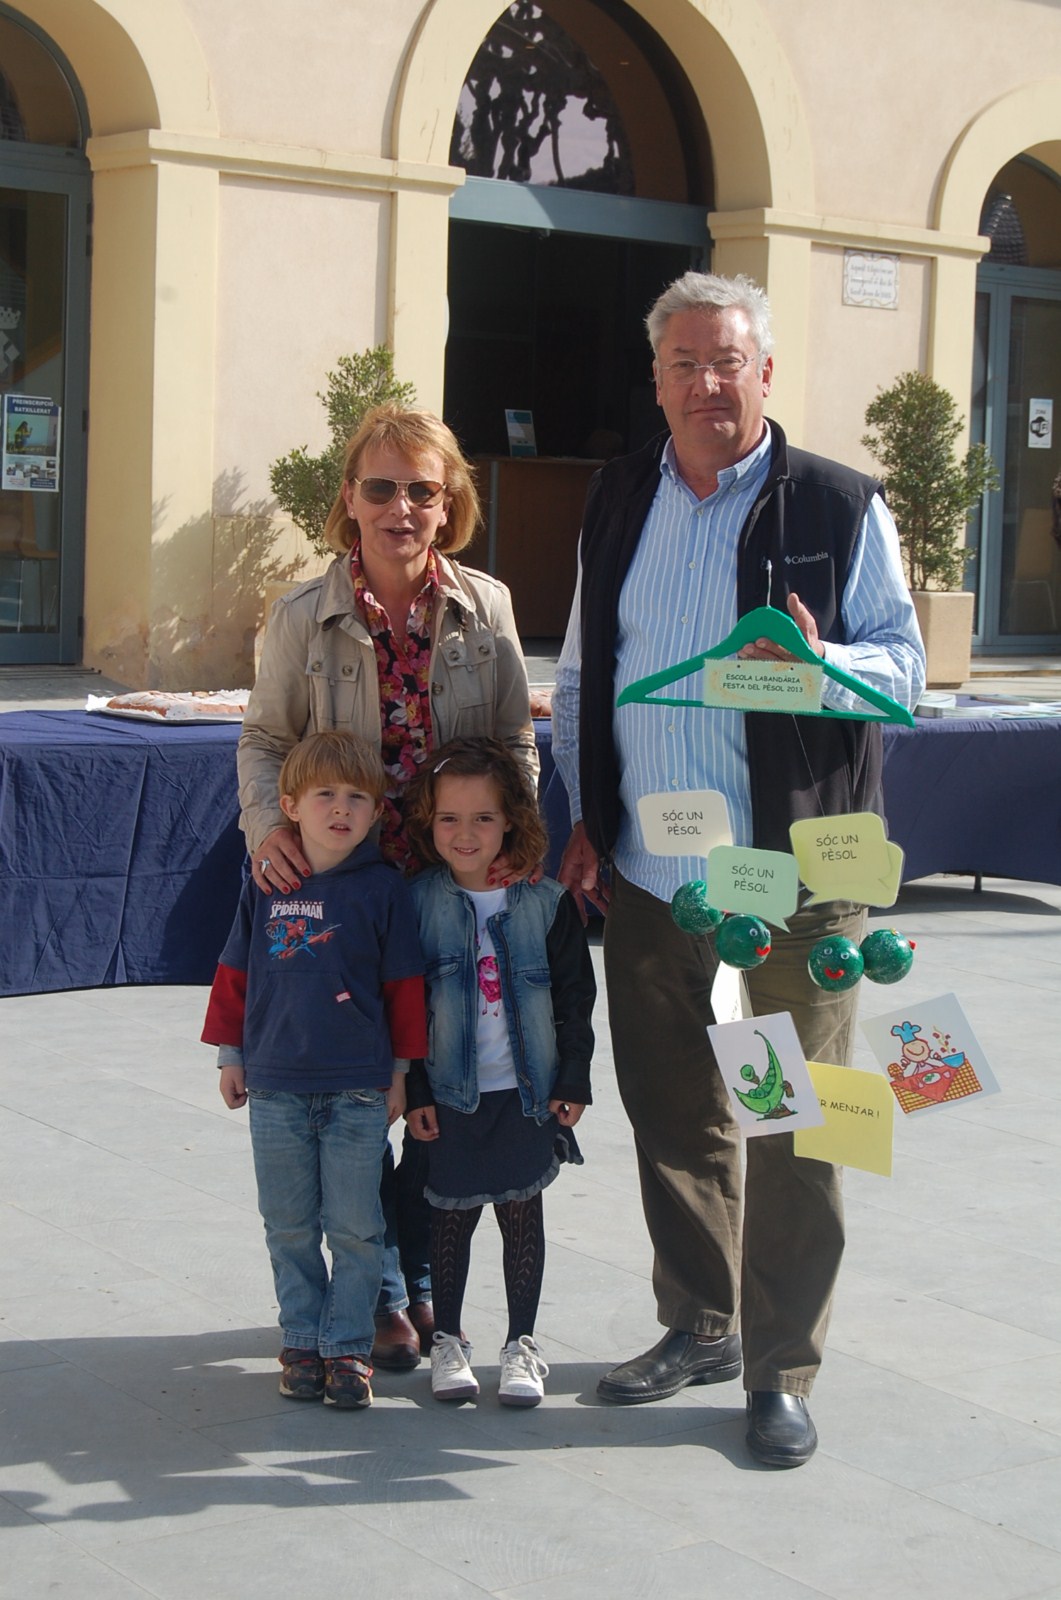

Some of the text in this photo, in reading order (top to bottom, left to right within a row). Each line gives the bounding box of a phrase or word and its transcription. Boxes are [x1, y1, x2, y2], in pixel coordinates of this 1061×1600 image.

[791, 552, 829, 565] Columbia
[662, 809, 703, 821] SÓC UN
[667, 823, 702, 836] PÈSOL
[816, 834, 859, 847] SÓC UN
[822, 848, 857, 861] PÈSOL
[731, 864, 774, 879] SÓC UN
[734, 878, 769, 893] PÈSOL
[269, 904, 323, 920] SPIDER-MAN
[830, 1101, 874, 1117] MENJAR
